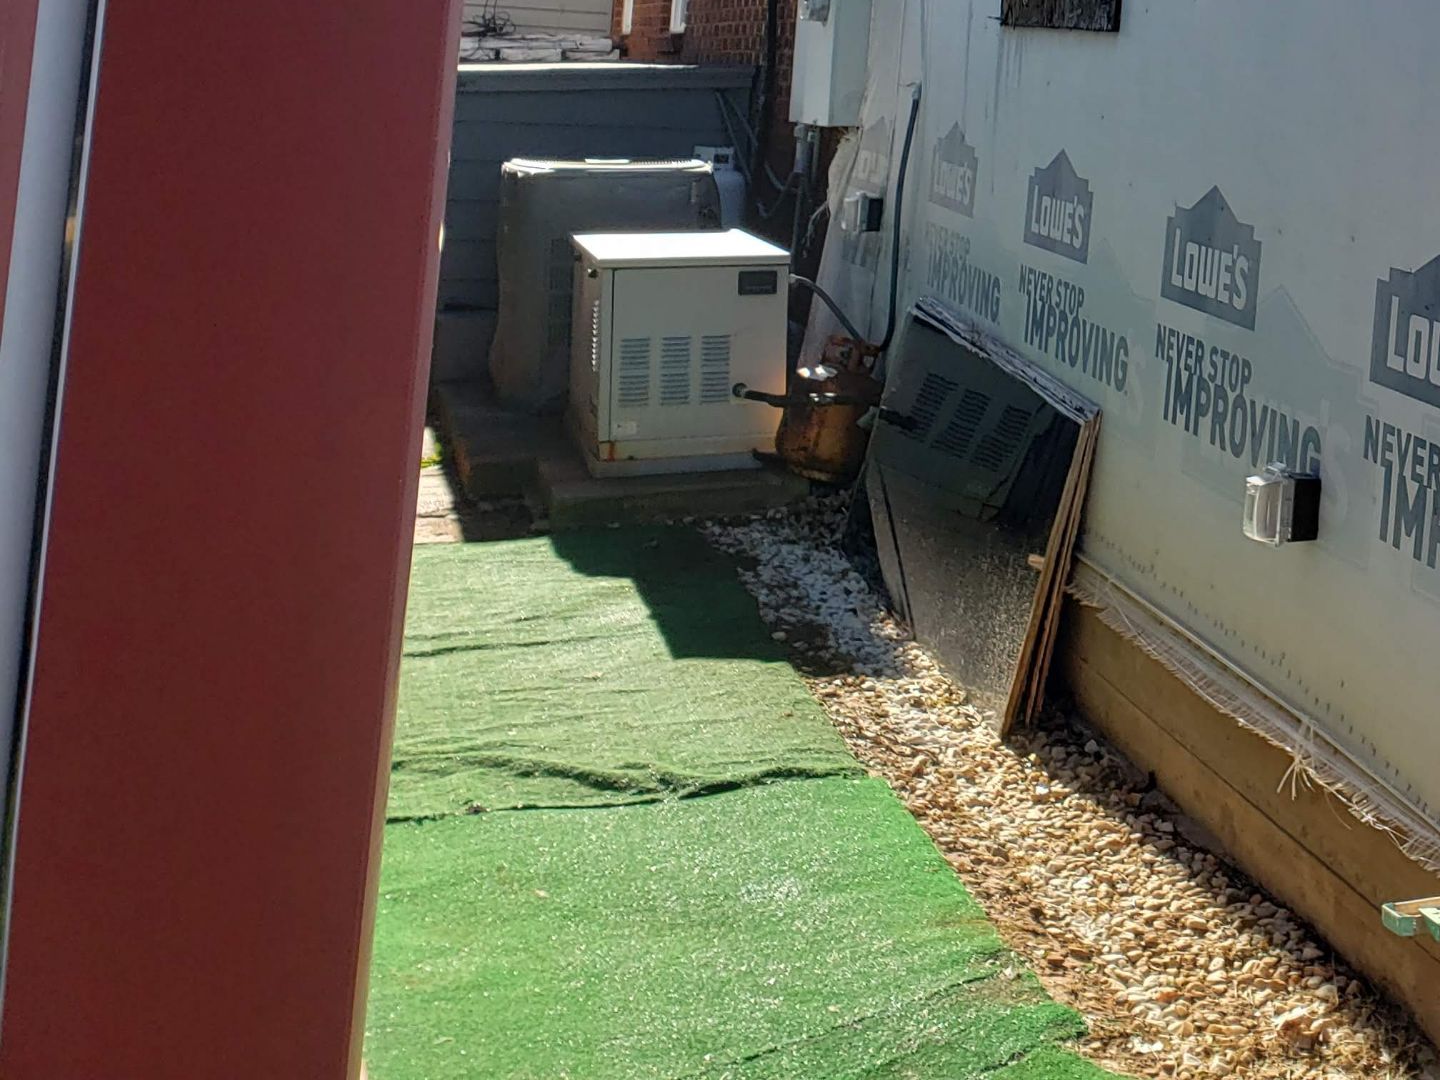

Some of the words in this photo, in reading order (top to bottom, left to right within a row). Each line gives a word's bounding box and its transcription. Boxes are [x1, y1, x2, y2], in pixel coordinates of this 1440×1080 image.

[1032, 185, 1084, 248] LOWE'S
[927, 250, 1000, 322] IMPROVING
[1019, 264, 1053, 305] NEVER
[1056, 278, 1084, 314] STOP
[1171, 228, 1248, 310] LOWE'S
[1024, 294, 1129, 392] IMPROVING
[1155, 323, 1204, 375] NEVER
[1208, 345, 1252, 394] STOP
[1163, 358, 1321, 477] IMPROVING
